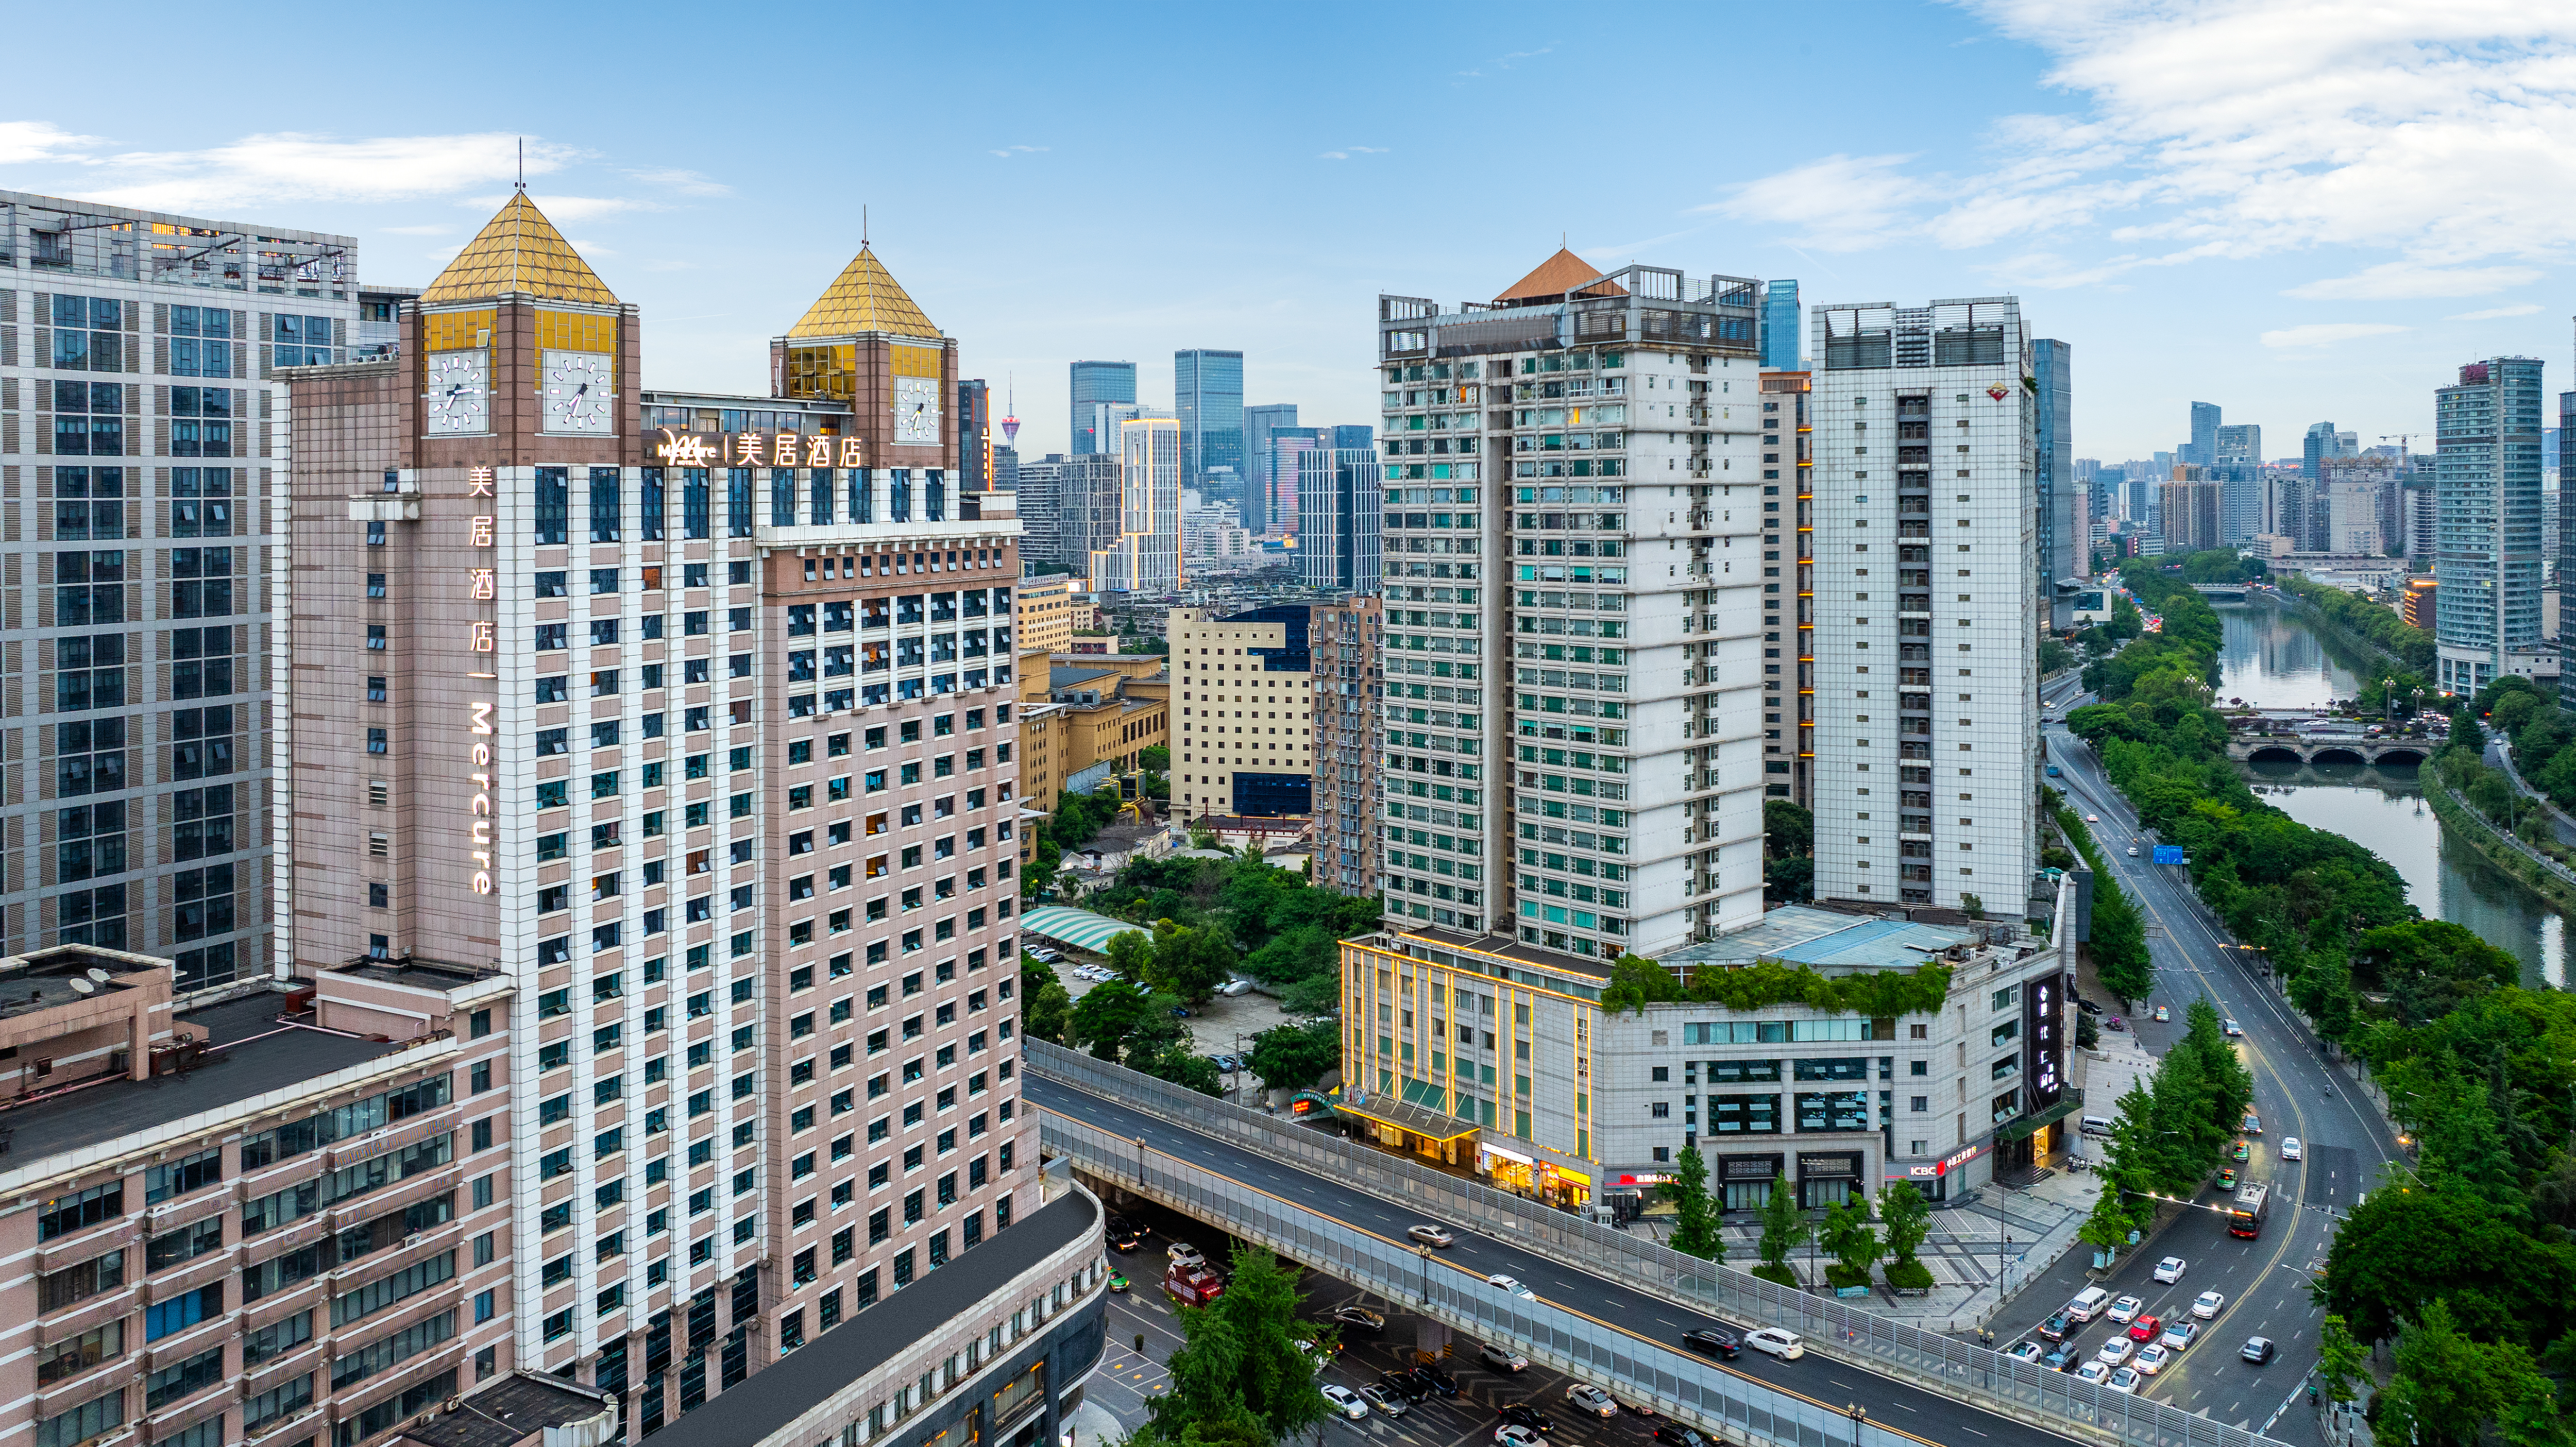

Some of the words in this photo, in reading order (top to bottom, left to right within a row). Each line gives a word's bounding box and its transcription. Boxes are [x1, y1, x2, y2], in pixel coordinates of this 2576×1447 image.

[737, 433, 862, 467] 美居酒店
[469, 466, 493, 652] 美居酒店
[471, 702, 492, 895] Mercure
[1910, 1166, 1936, 1176] ICBC
